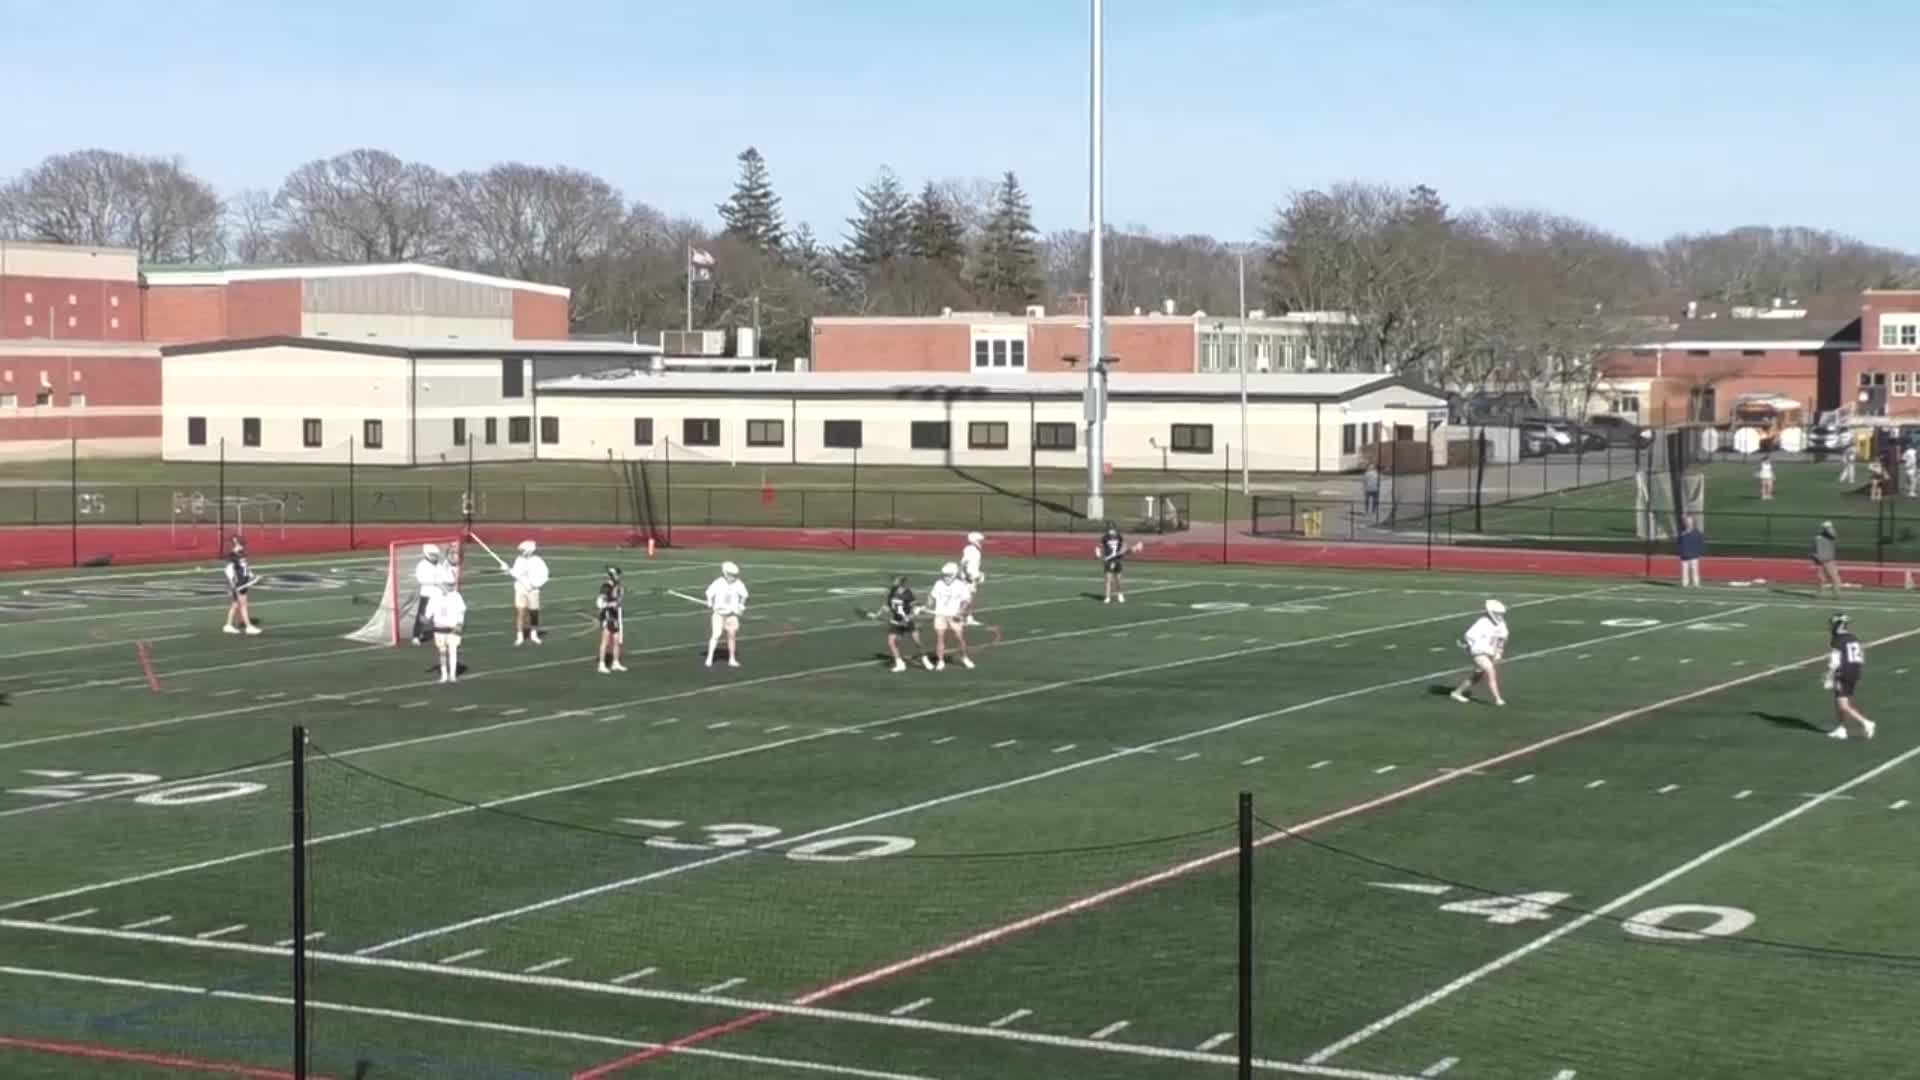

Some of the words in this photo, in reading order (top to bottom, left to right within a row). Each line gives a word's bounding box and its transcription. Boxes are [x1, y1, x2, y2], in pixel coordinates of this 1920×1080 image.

[3, 772, 268, 805] 20
[645, 823, 916, 861] 30
[1438, 891, 1756, 939] 40
